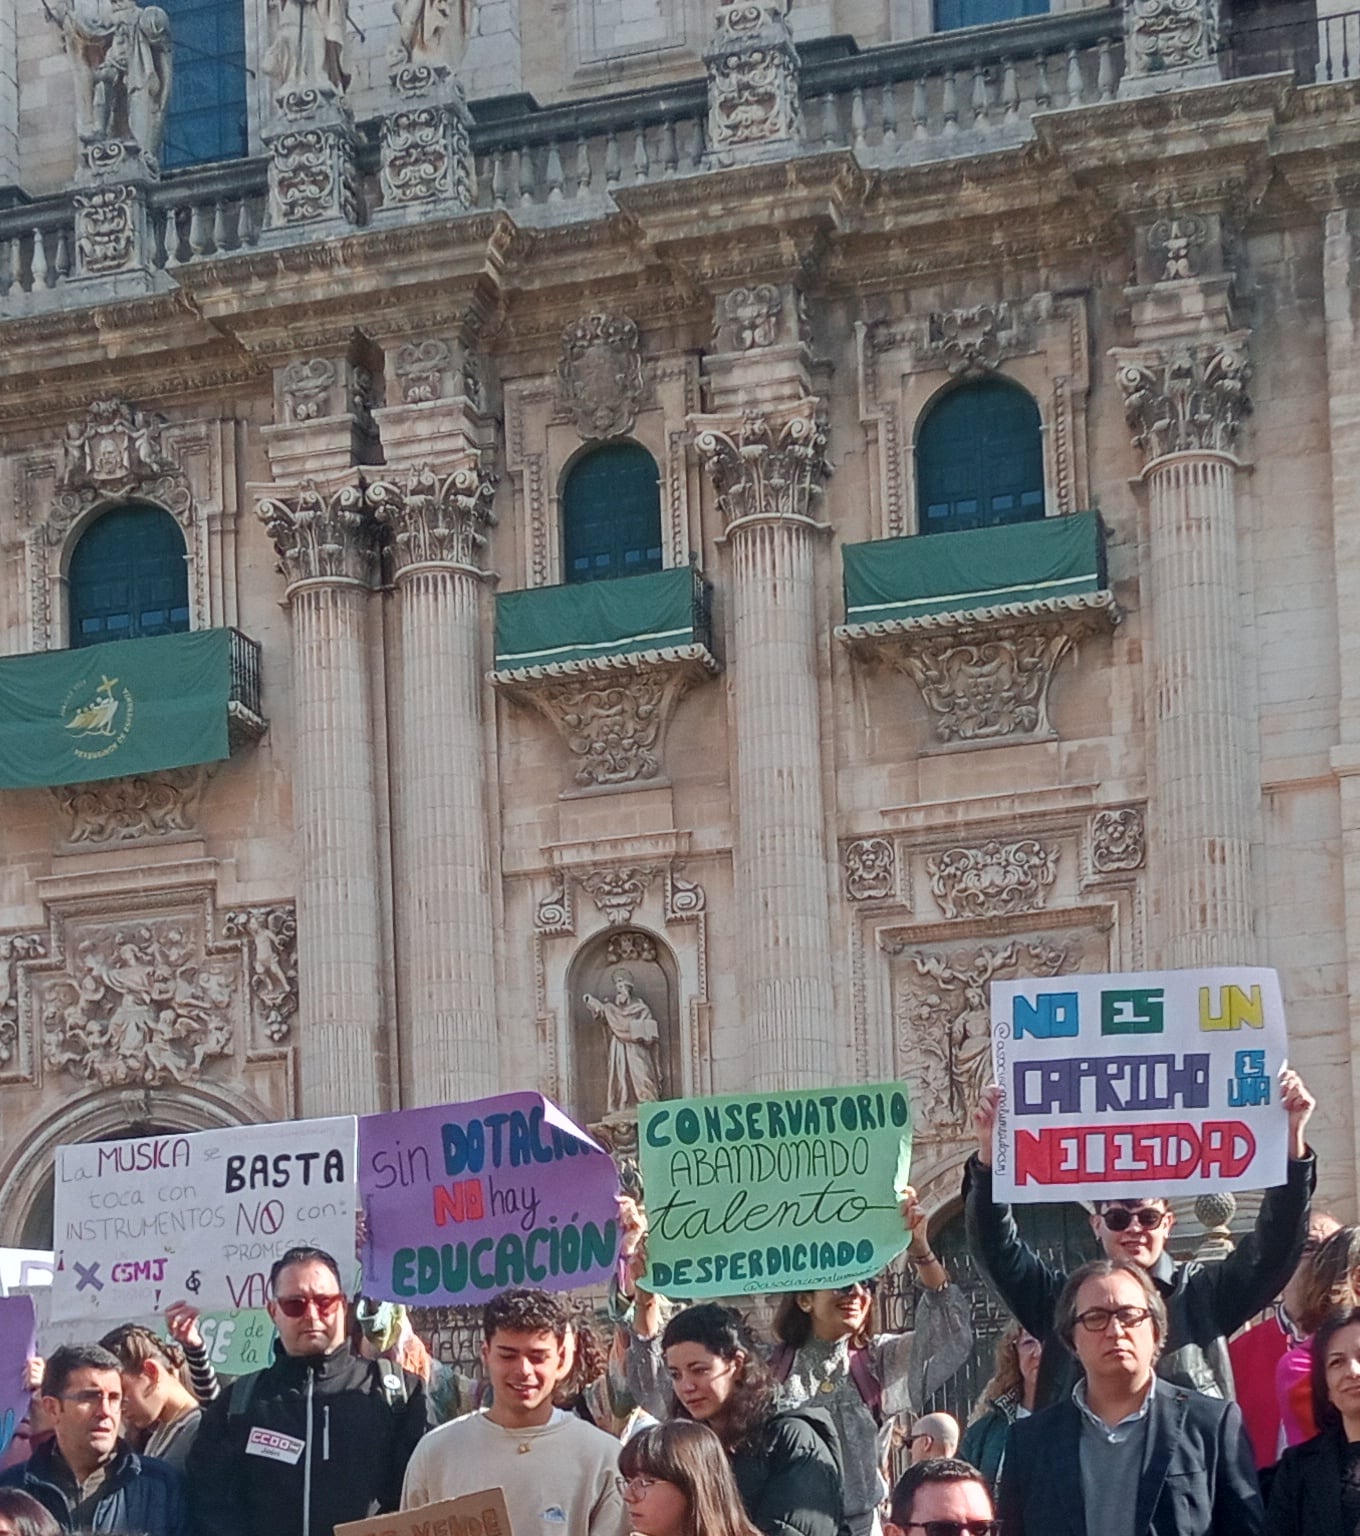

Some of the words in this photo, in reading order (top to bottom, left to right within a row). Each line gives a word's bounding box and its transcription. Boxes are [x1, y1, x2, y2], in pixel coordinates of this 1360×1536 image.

[1013, 992, 1079, 1040] NO
[1101, 988, 1165, 1037] ES
[1198, 984, 1265, 1032] UN
[1013, 1053, 1211, 1116] CAPRICHO
[1234, 1049, 1266, 1079] ES
[1227, 1075, 1271, 1108] UNA
[646, 1091, 908, 1148] CONSERVATORIO
[61, 1152, 90, 1183] La
[97, 1137, 191, 1178] MUSICA
[225, 1148, 345, 1194] BASTA
[669, 1136, 870, 1188] ABANDONADO
[1014, 1121, 1257, 1187] NECESIDAD
[88, 1189, 145, 1209] toca
[157, 1184, 197, 1203] con
[433, 1178, 484, 1227] NO
[489, 1174, 541, 1231] hay
[646, 1180, 898, 1241] talento
[66, 1205, 226, 1241] INSTRUMENTOS
[235, 1199, 285, 1236] NO
[111, 1257, 169, 1284] CSMJ
[652, 1238, 875, 1288] DESPERDICIADO
[243, 1320, 264, 1338] de
[239, 1342, 260, 1364] la
